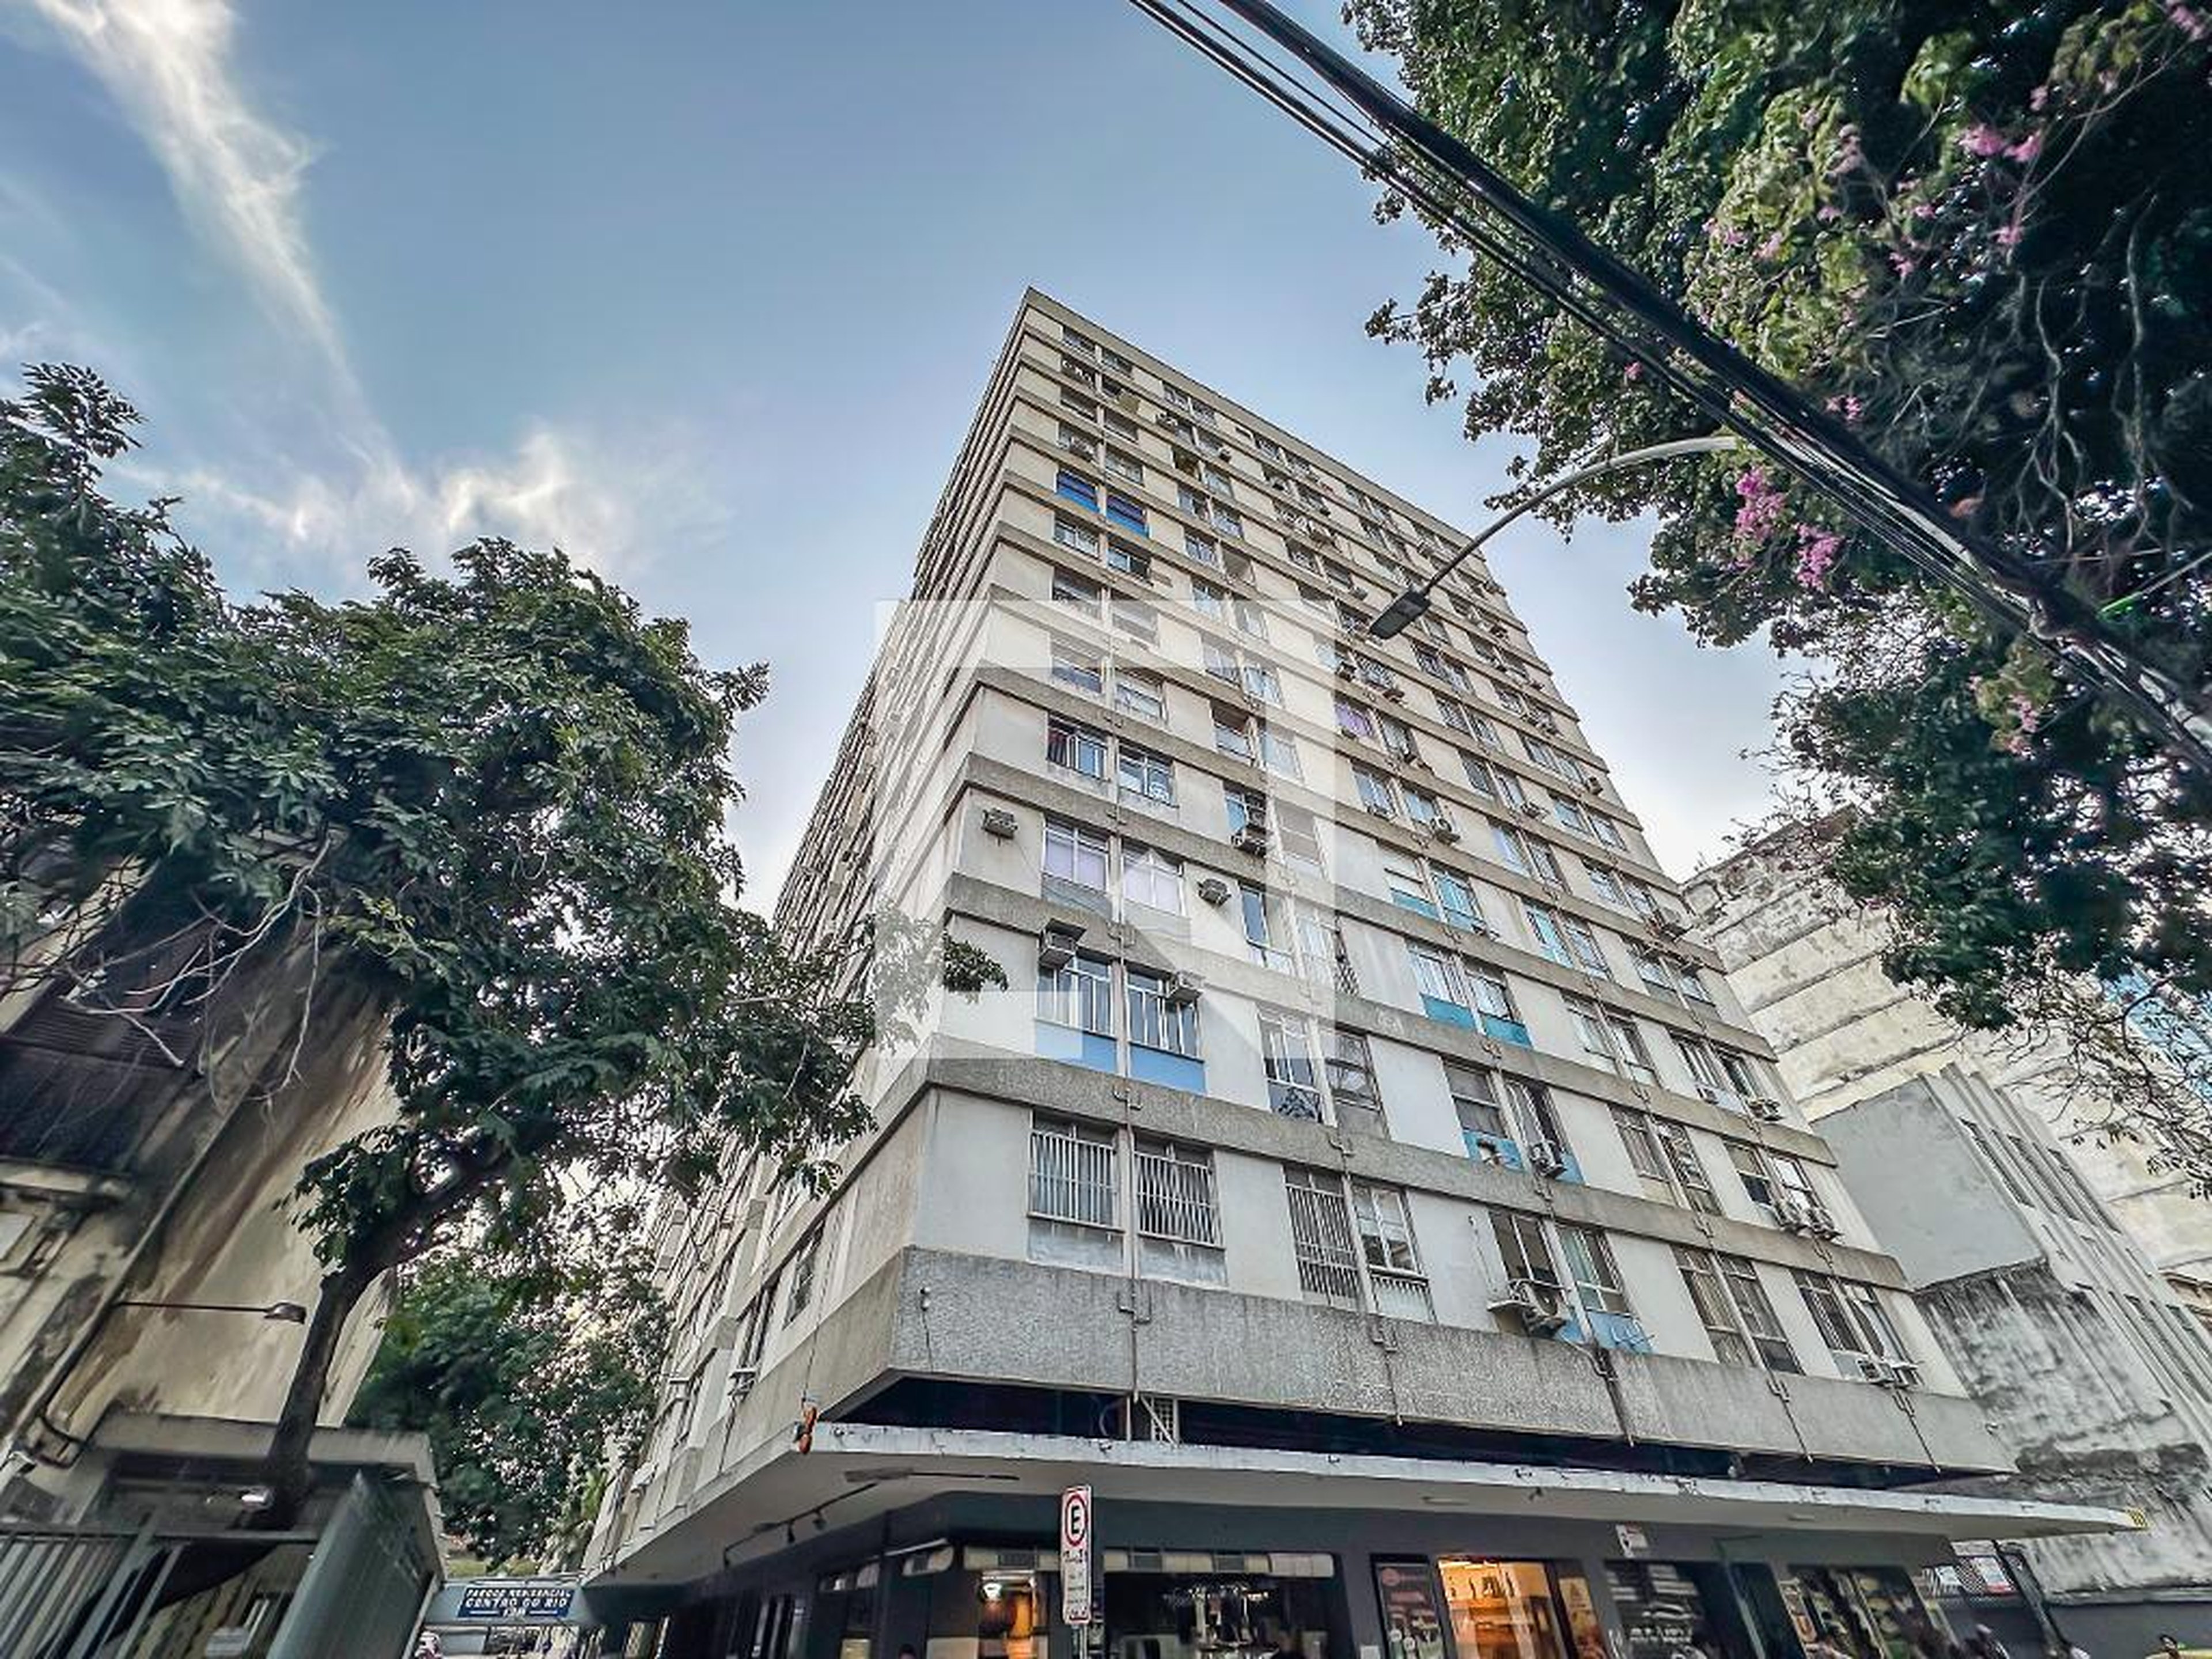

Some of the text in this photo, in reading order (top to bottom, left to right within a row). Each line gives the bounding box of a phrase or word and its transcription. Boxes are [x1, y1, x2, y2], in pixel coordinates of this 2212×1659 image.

[1071, 1505, 1080, 1534] E
[465, 1598, 517, 1608] CENTRO
[544, 1598, 567, 1608] RIO
